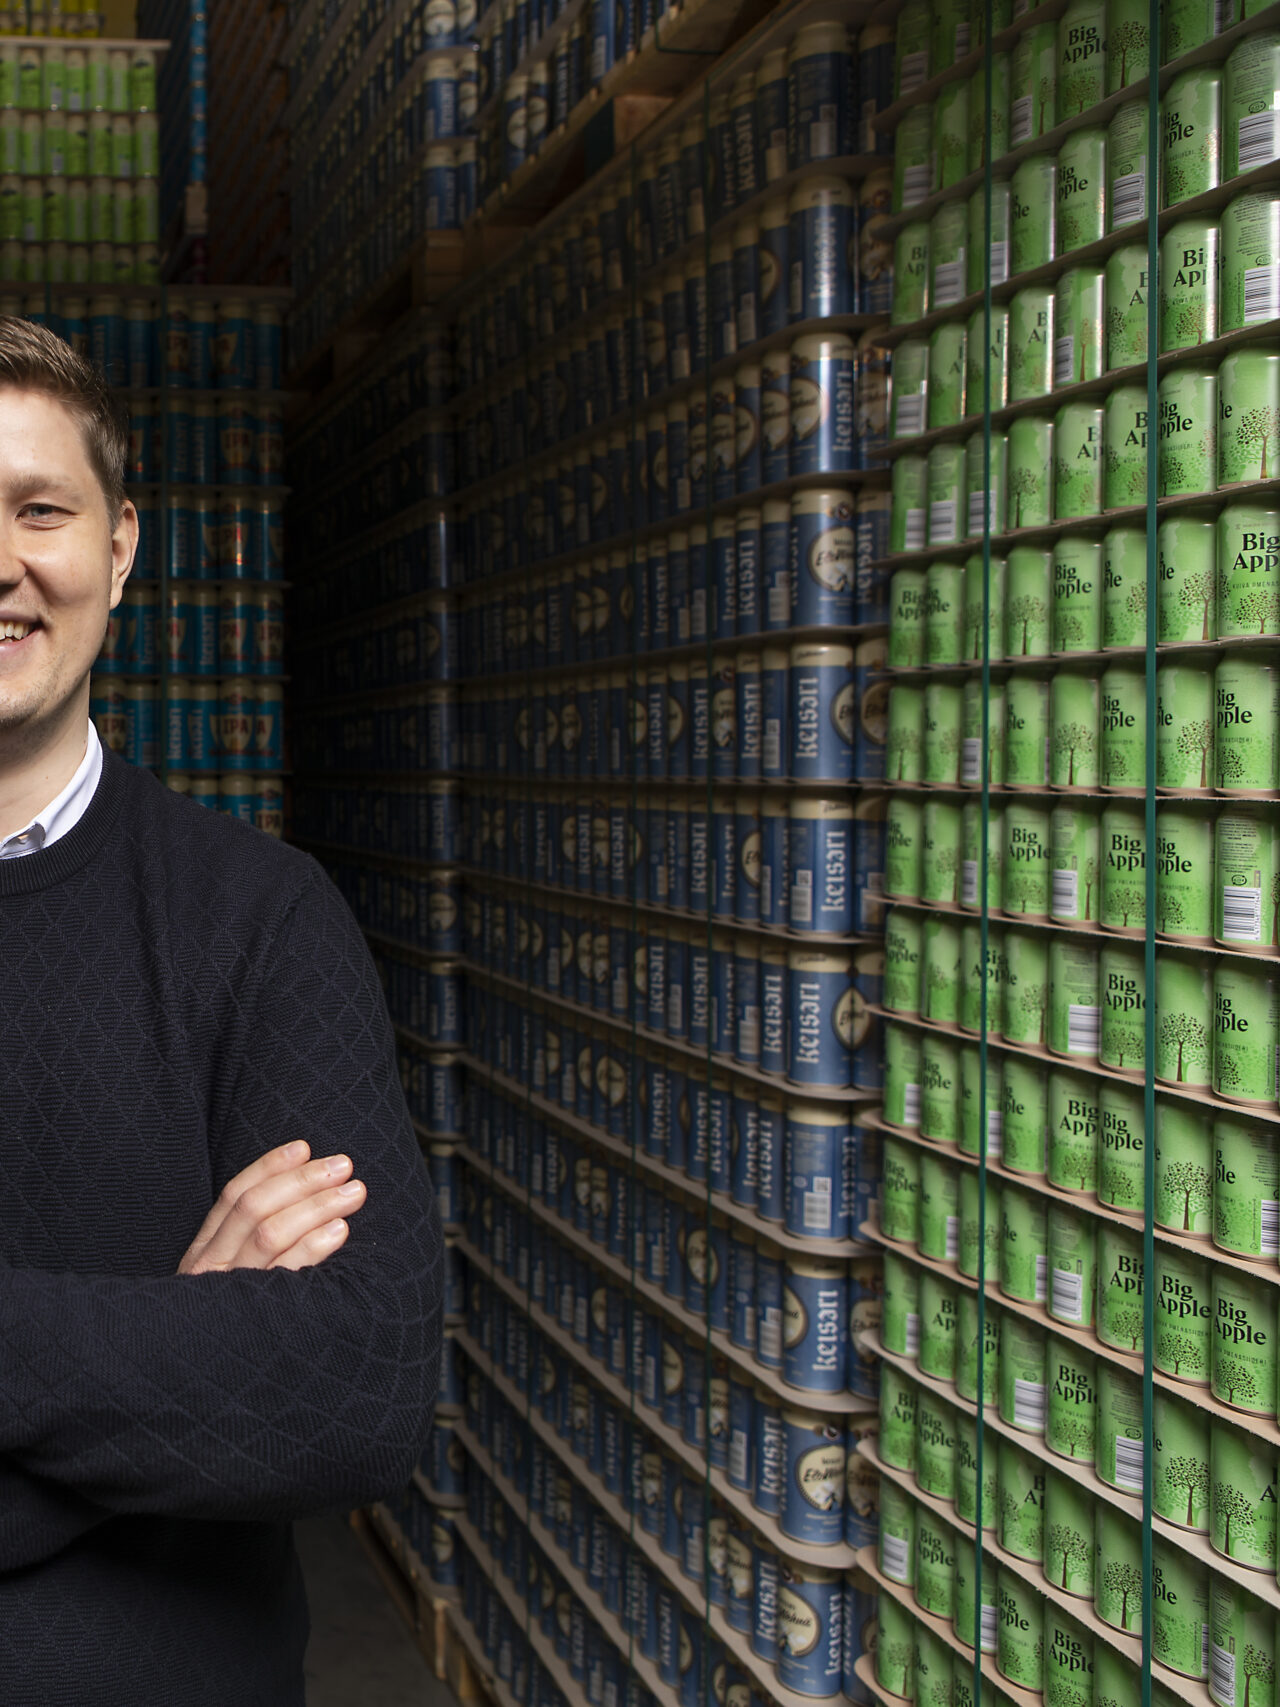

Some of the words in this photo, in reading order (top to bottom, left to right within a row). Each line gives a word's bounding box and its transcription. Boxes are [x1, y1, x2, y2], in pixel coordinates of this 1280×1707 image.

[1068, 25, 1098, 46] Big
[833, 370, 852, 452] keisari
[1241, 532, 1280, 553] Big
[741, 682, 759, 759] keisari
[795, 677, 818, 759] keisari
[1012, 828, 1037, 847] Big
[1111, 834, 1141, 856] Big
[691, 821, 707, 895] keisari
[822, 831, 845, 914] keisari
[1108, 973, 1137, 995] Big
[764, 974, 782, 1054] keisari
[796, 982, 820, 1064] keisari
[1068, 1100, 1099, 1123] Big
[1103, 1111, 1128, 1133] Big
[1162, 1275, 1193, 1302] Big
[1156, 1291, 1212, 1318] Apple
[1217, 1298, 1248, 1327] Big
[812, 1290, 839, 1370] keisari
[1215, 1315, 1267, 1346] Apple
[1058, 1364, 1088, 1387] Big
[756, 1562, 778, 1641] keisari
[1054, 1629, 1082, 1653] Big
